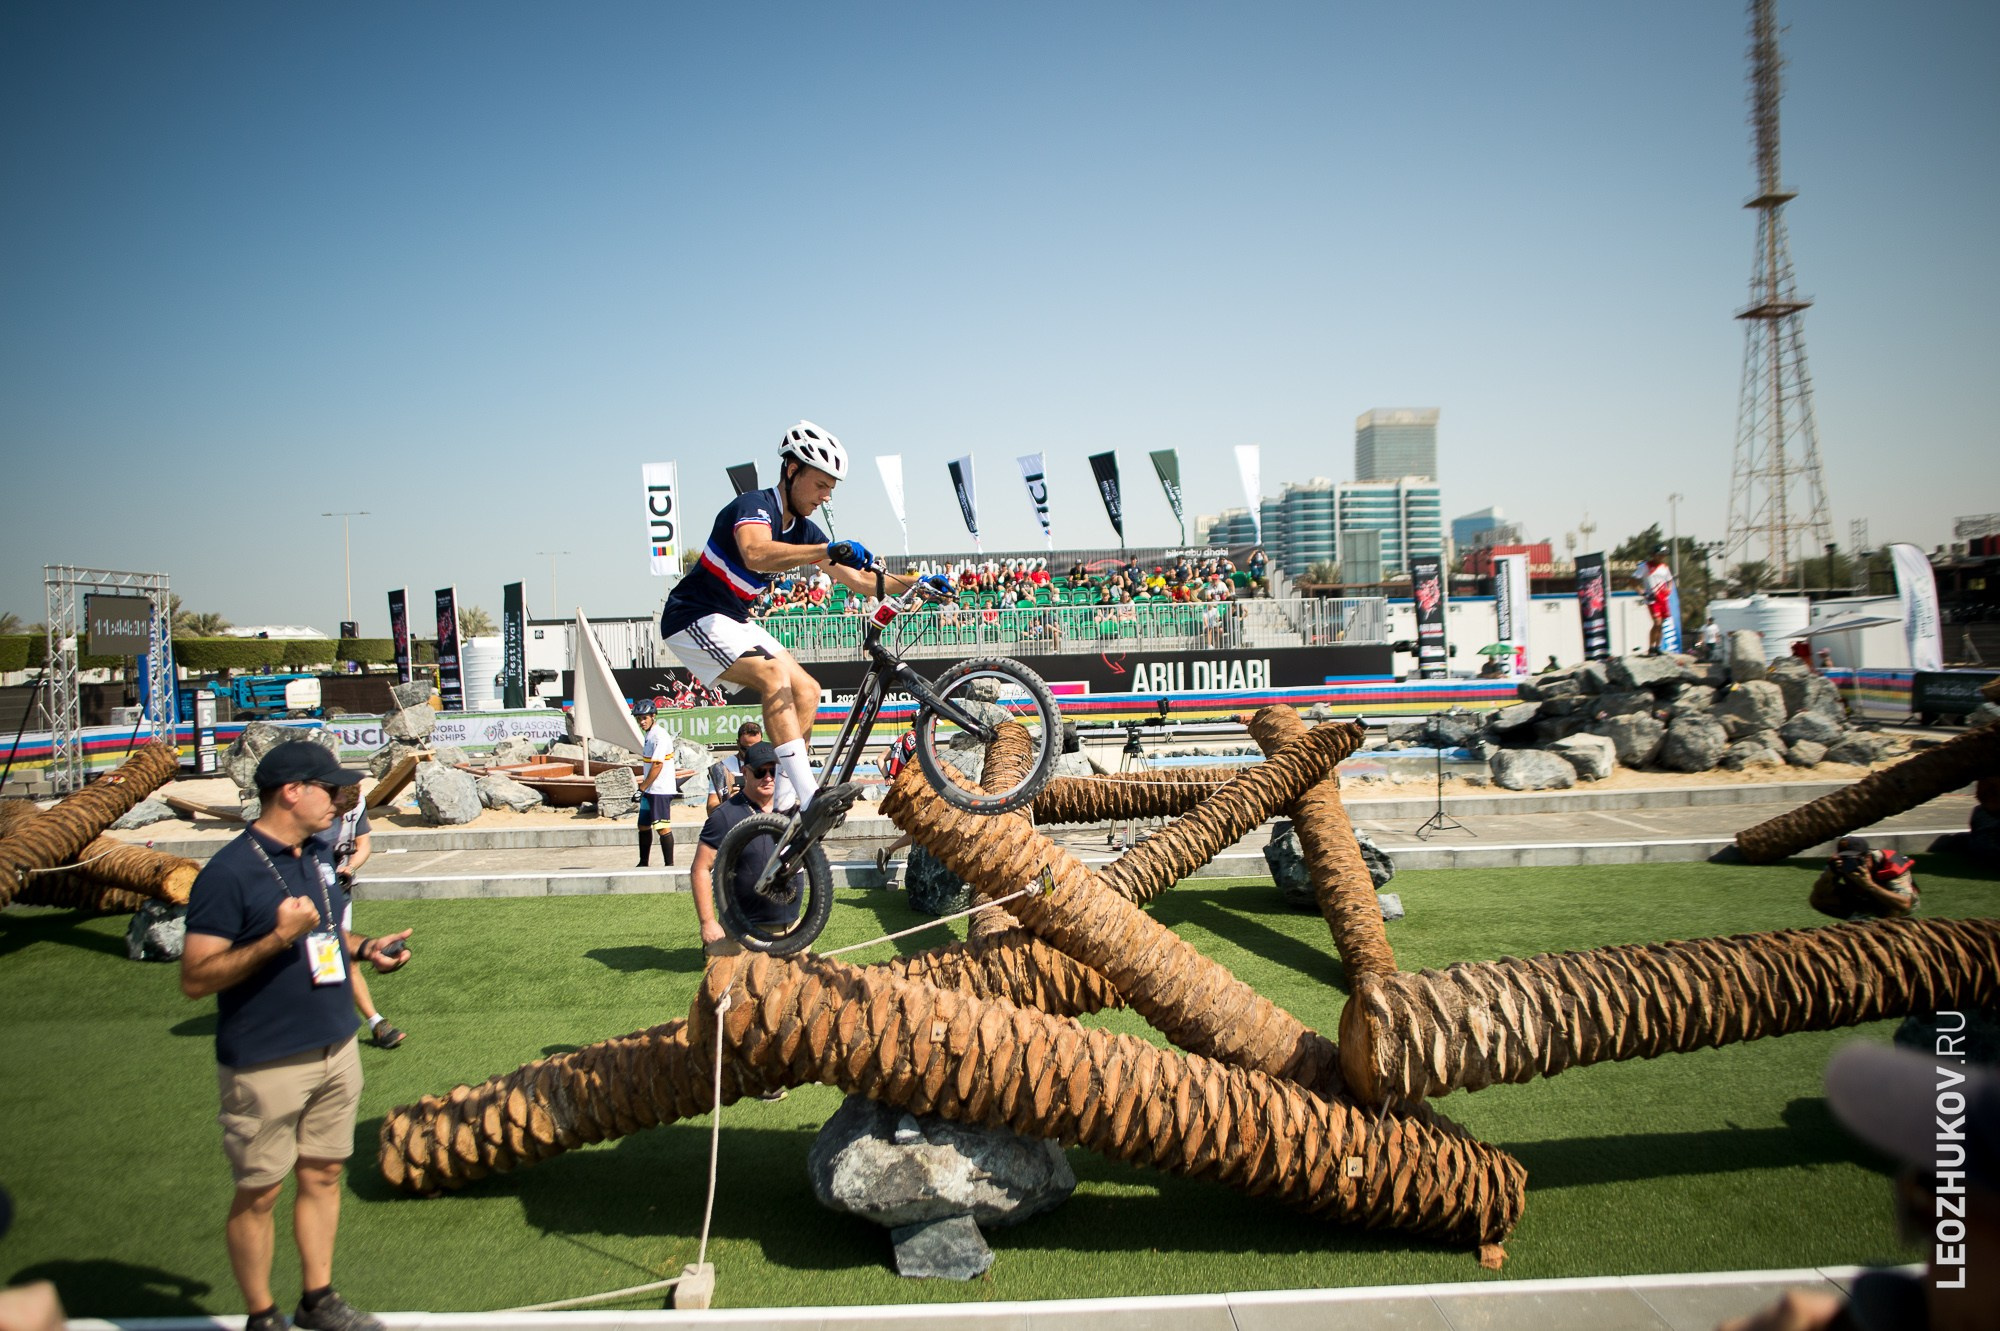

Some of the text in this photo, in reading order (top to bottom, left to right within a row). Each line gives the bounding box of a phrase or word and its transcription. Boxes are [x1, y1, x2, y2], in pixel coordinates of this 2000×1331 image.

[648, 485, 674, 543] UCI
[1185, 548, 1202, 556] abu
[1204, 547, 1229, 556] dhabi
[1132, 659, 1271, 693] ABU DHABI
[884, 692, 897, 701] AN
[899, 691, 912, 701] CY
[203, 709, 212, 726] 5
[511, 721, 561, 731] GLASGOW
[656, 714, 766, 738] OU IN 20
[343, 729, 385, 745] UCI
[430, 734, 466, 742] NSHIPS
[512, 730, 562, 739] SCOTLAND
